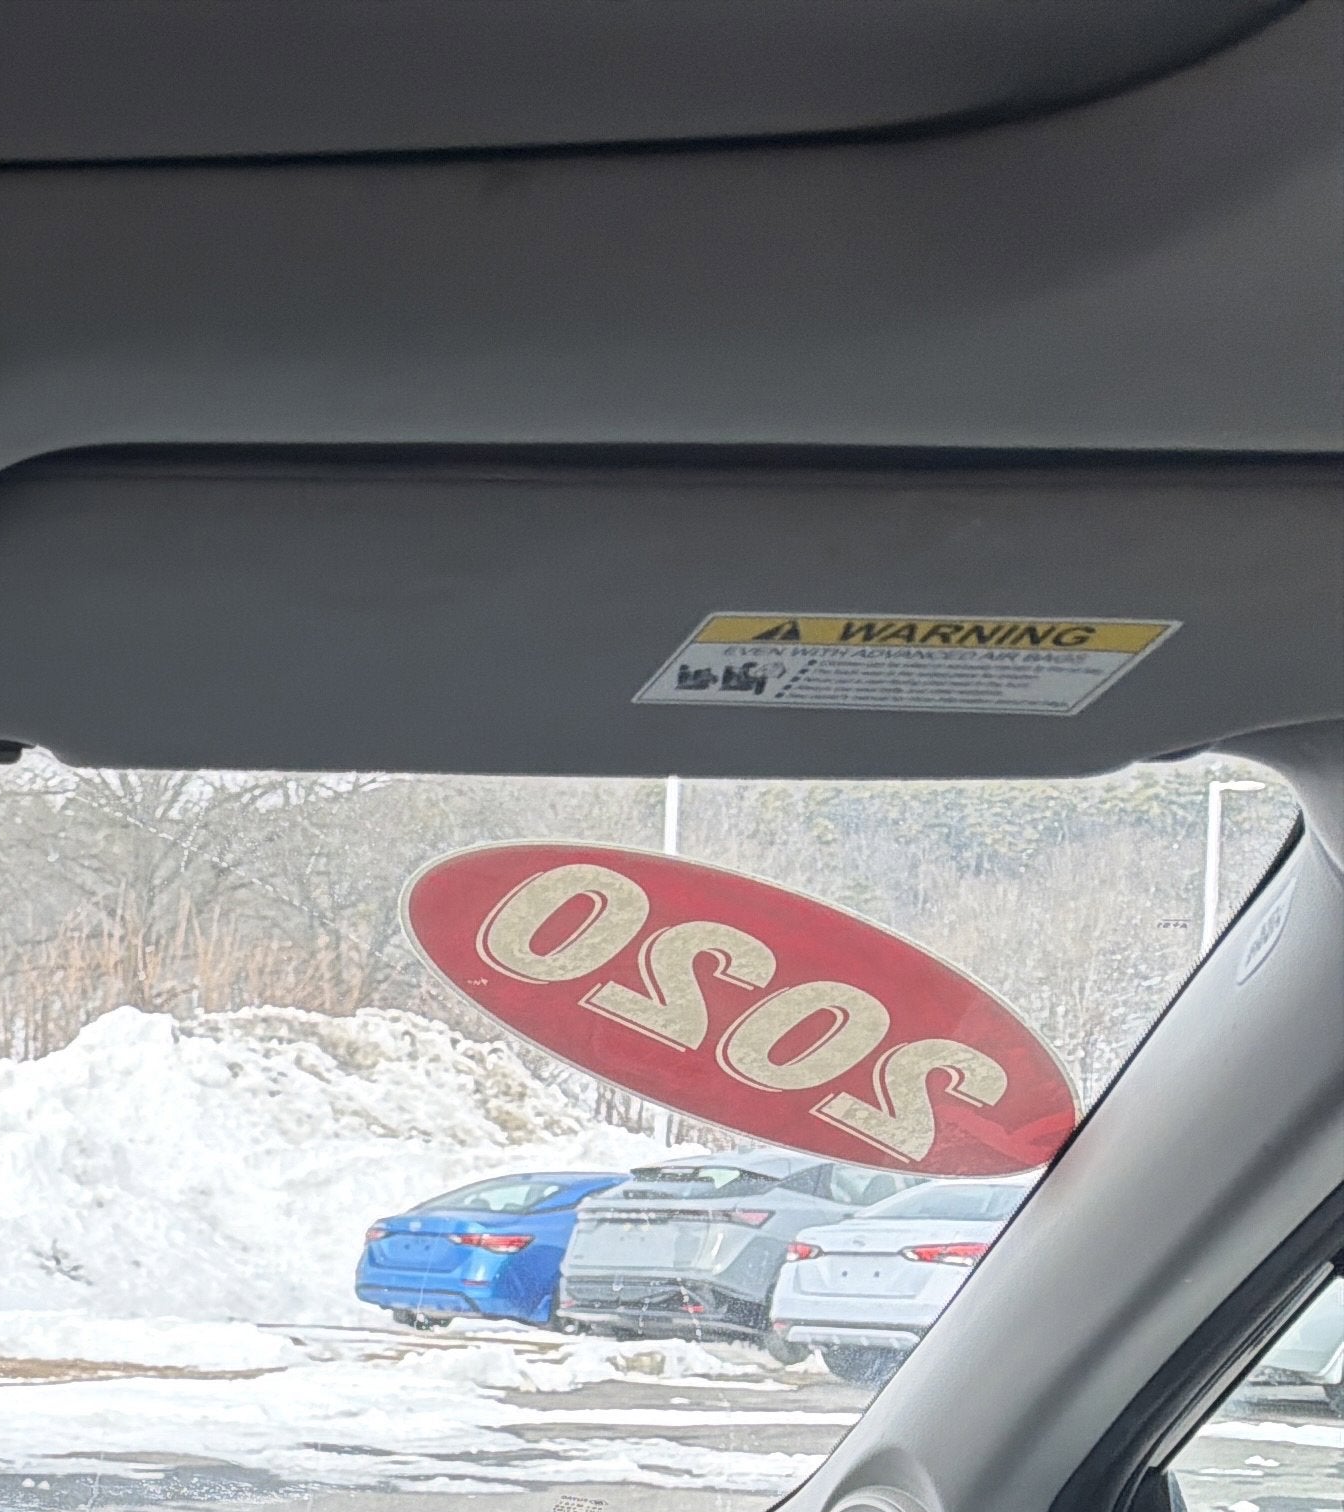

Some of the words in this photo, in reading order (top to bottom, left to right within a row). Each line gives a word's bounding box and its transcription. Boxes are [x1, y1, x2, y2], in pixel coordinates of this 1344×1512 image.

[840, 622, 1096, 646] WARNING
[724, 647, 784, 657] EVEN
[791, 647, 848, 658] WITH
[852, 648, 979, 661] ADVANCED
[980, 651, 1021, 661] AIR
